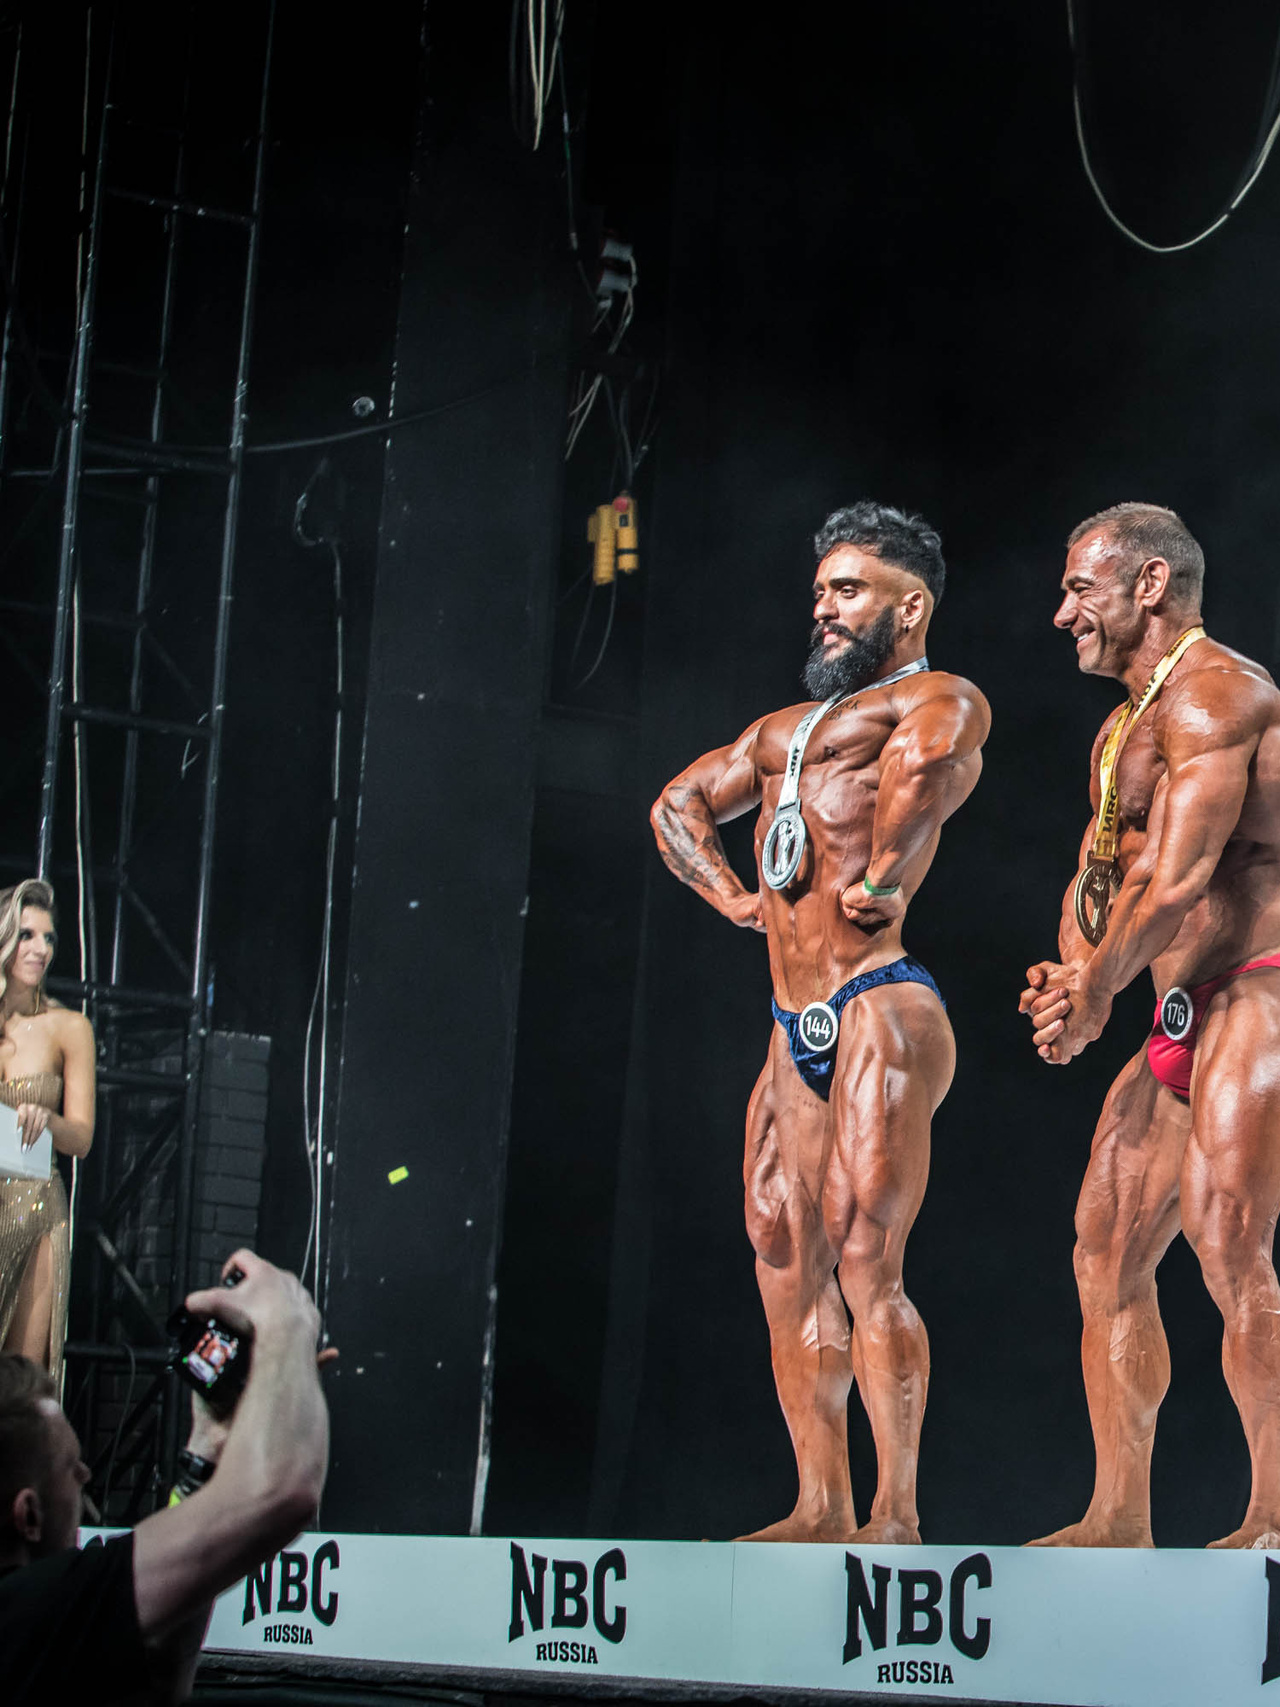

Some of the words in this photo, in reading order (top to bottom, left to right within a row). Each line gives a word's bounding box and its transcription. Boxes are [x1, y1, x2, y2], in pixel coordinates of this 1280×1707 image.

[1167, 1002, 1185, 1026] 176
[805, 1015, 831, 1040] 144
[242, 1539, 340, 1627] NBC
[508, 1540, 627, 1645] NBC
[842, 1550, 993, 1665] NBC
[263, 1623, 314, 1645] RUSSIA
[535, 1640, 599, 1665] RUSSIA
[876, 1659, 955, 1685] RUSSIA
